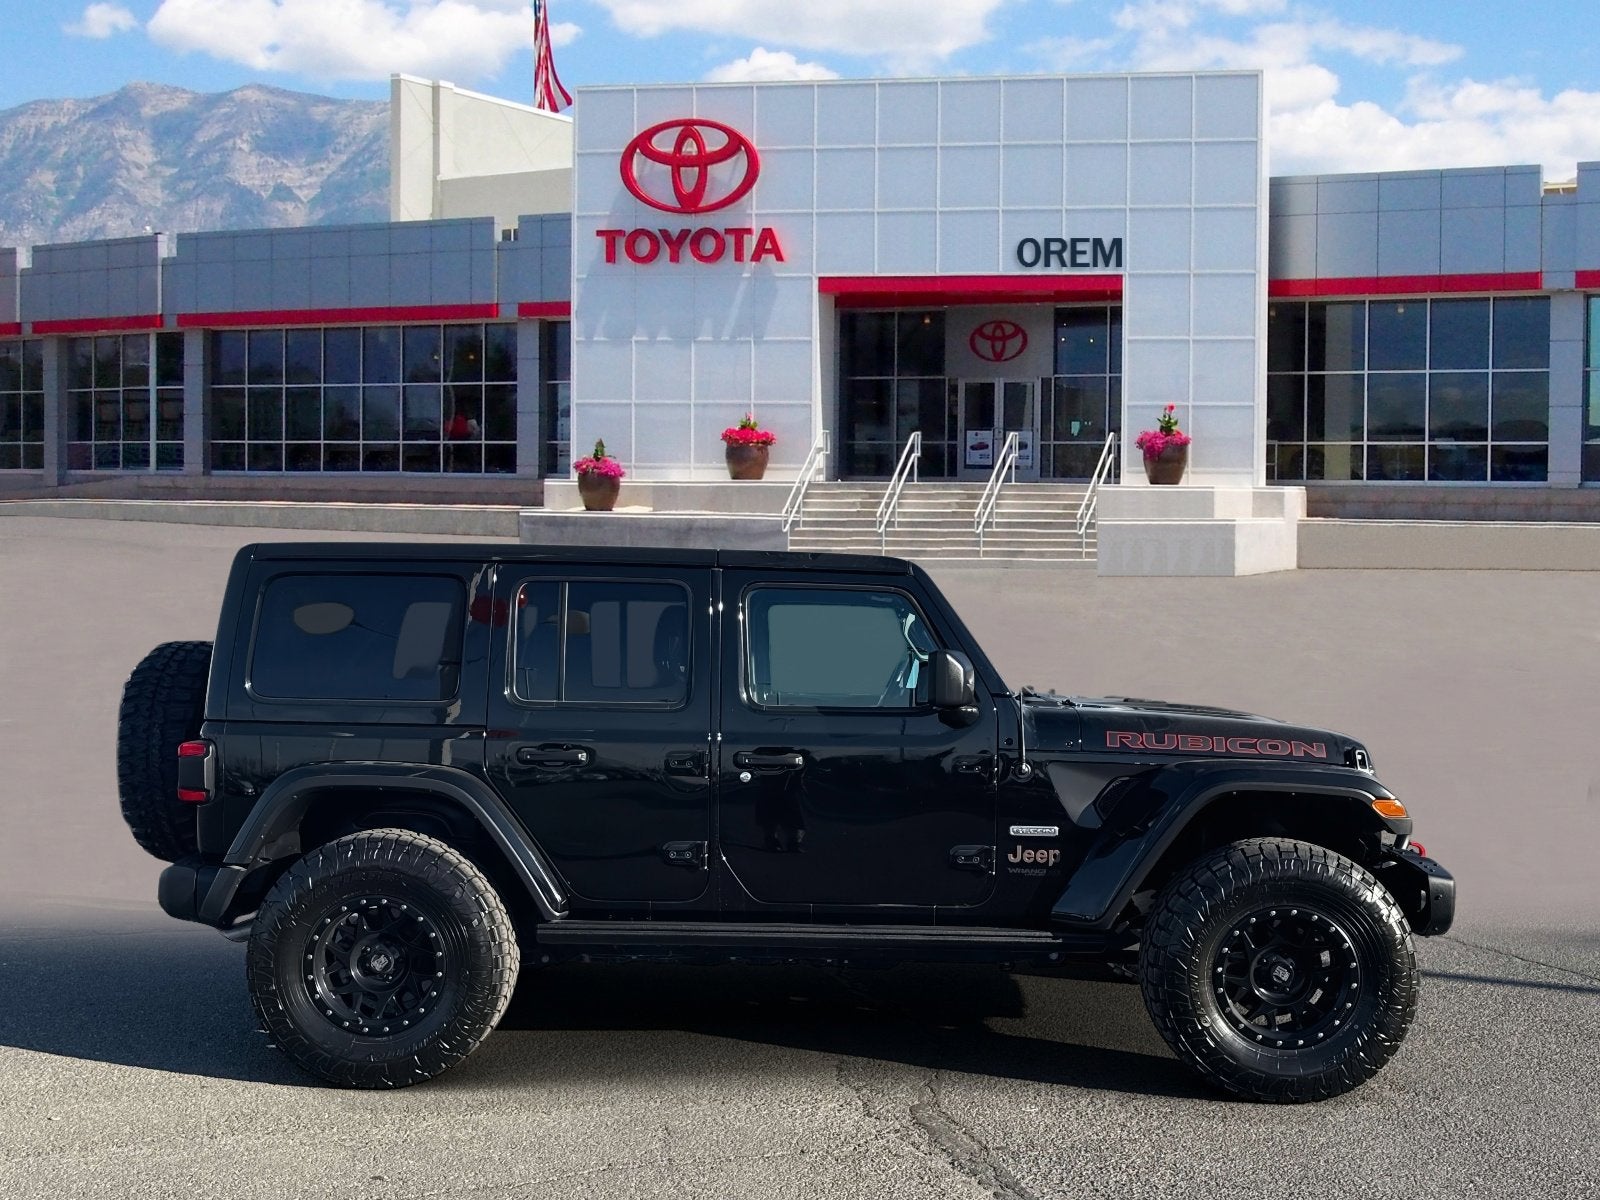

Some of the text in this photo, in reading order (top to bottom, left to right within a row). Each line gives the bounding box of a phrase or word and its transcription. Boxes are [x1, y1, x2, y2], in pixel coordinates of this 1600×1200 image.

[596, 227, 785, 264] TOYOTA
[1016, 237, 1123, 268] OREM
[1106, 730, 1327, 758] RUBICON
[1007, 845, 1060, 867] Jeep
